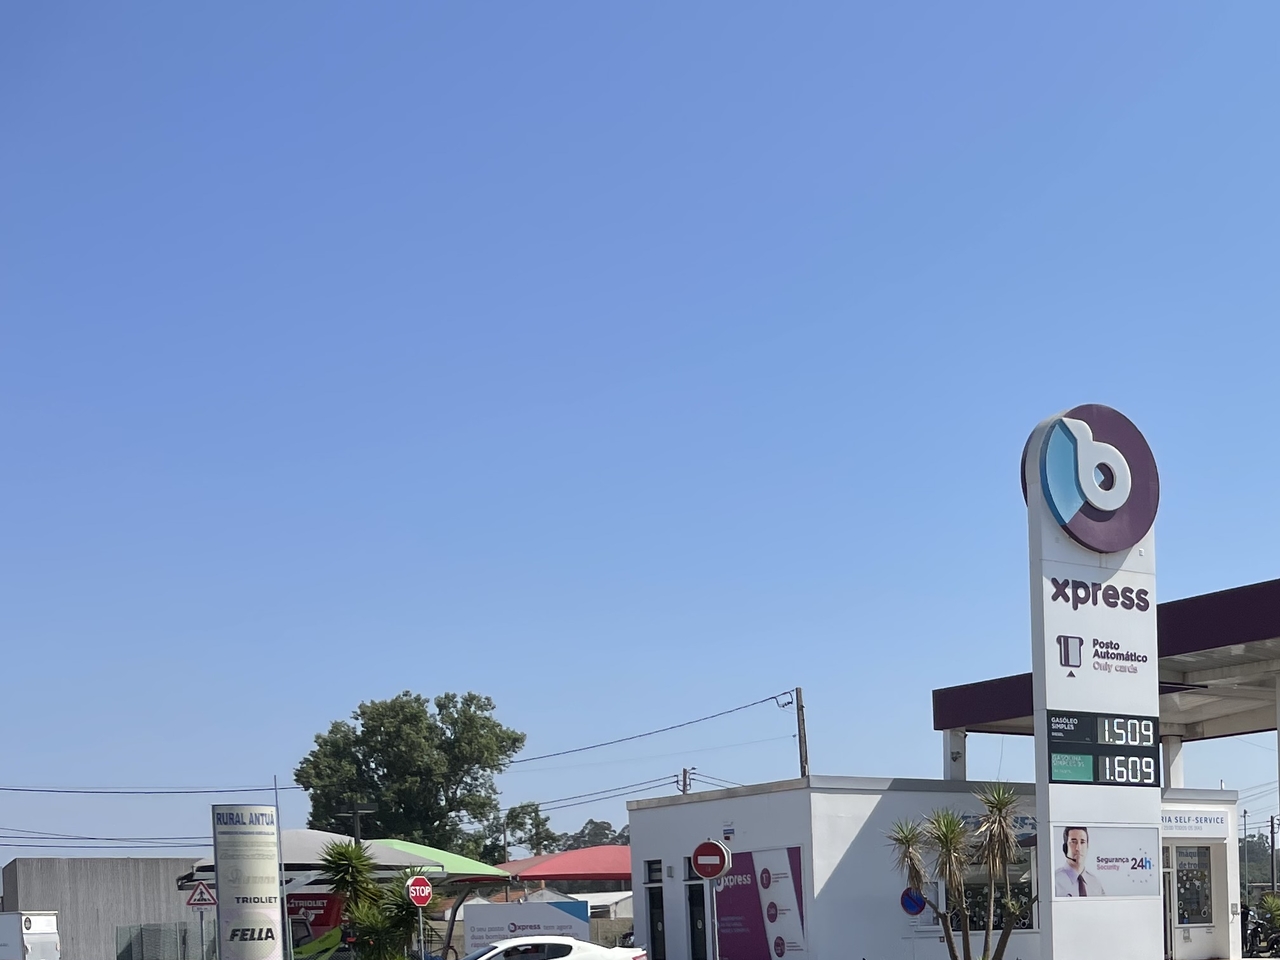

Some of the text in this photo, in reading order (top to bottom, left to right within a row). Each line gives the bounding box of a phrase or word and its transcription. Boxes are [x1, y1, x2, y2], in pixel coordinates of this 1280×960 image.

[1051, 577, 1150, 612] xpress
[1092, 638, 1120, 650] Posto
[1092, 649, 1148, 663] Automático
[1092, 661, 1138, 674] Only cards
[1051, 716, 1153, 746] GASÓLEO 1.509
[1105, 756, 1154, 784] 1.609
[216, 812, 246, 826] RURAL
[1174, 816, 1225, 824] SELF-SERVICE
[1096, 856, 1152, 870] Segurança 24h
[410, 886, 431, 897] STOP
[235, 896, 278, 904] TRIOLIET
[229, 928, 275, 941] FELLA
